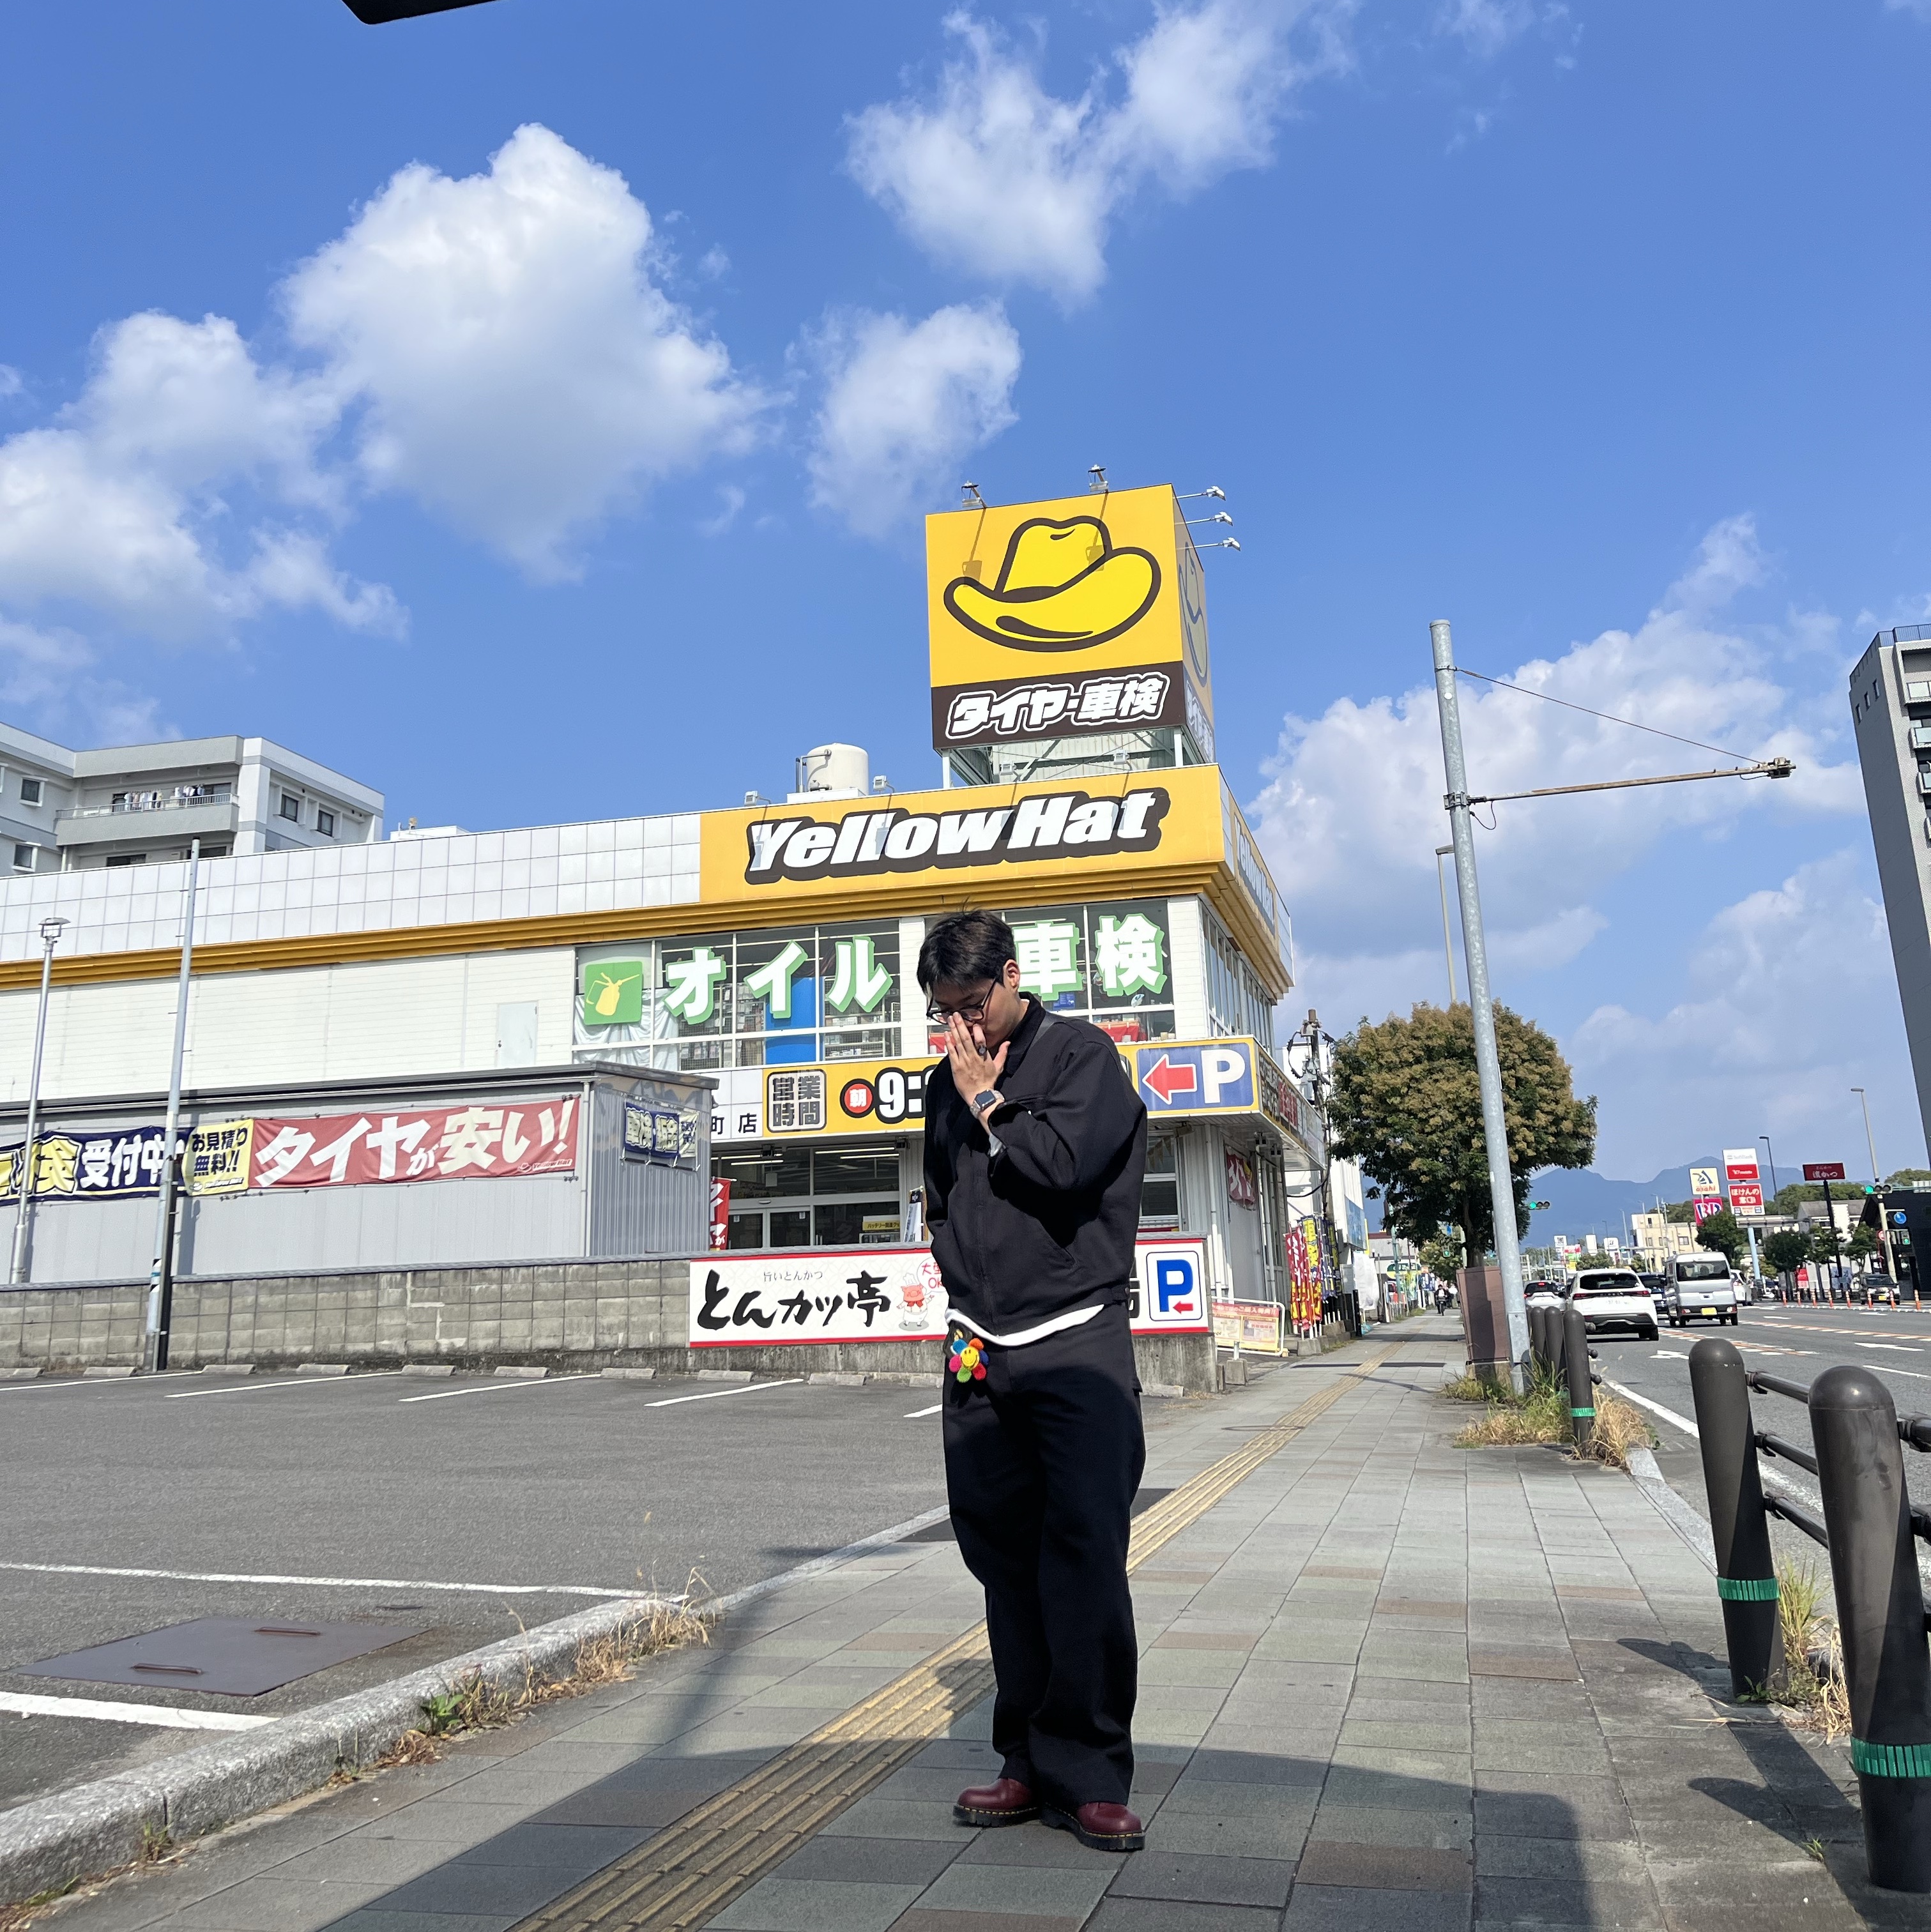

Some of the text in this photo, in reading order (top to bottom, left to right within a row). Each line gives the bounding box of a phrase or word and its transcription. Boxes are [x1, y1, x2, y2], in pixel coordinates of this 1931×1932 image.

[664, 915, 1164, 1019] オイル 車検
[773, 1076, 821, 1101] 営業
[1202, 1049, 1246, 1104] P
[849, 1088, 867, 1108] 朝
[773, 1100, 821, 1127] 時間
[192, 1127, 248, 1153] お見積り
[194, 1149, 240, 1176] 無料!!
[1731, 1187, 1760, 1196] ほけんの
[1156, 1259, 1194, 1312] P
